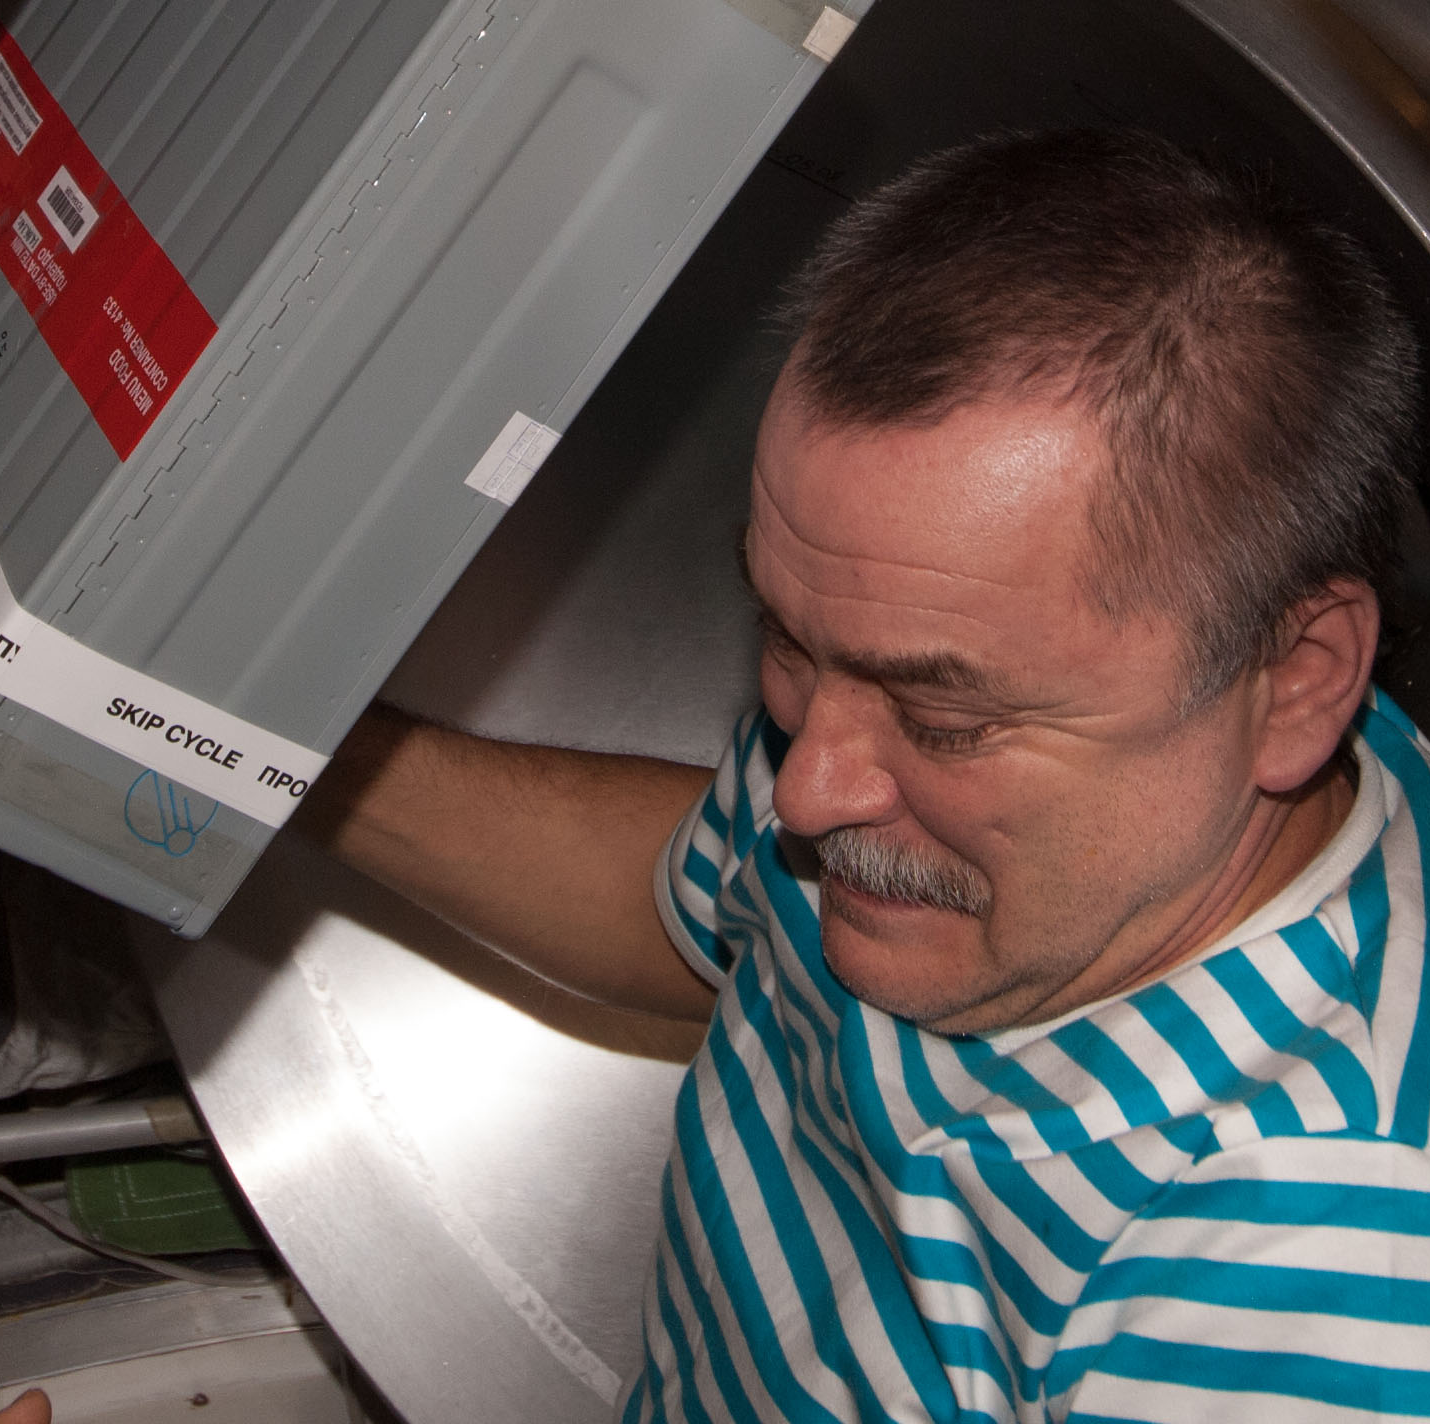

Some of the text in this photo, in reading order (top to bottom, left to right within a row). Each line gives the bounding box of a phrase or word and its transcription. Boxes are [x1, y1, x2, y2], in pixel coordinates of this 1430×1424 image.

[31, 270, 62, 307] USE-BY
[103, 296, 168, 392] CONTAINER No: 4133
[109, 348, 153, 416] MENU FOOD
[107, 698, 243, 770] SKIP CYCLE
[257, 765, 315, 802] ПРО
